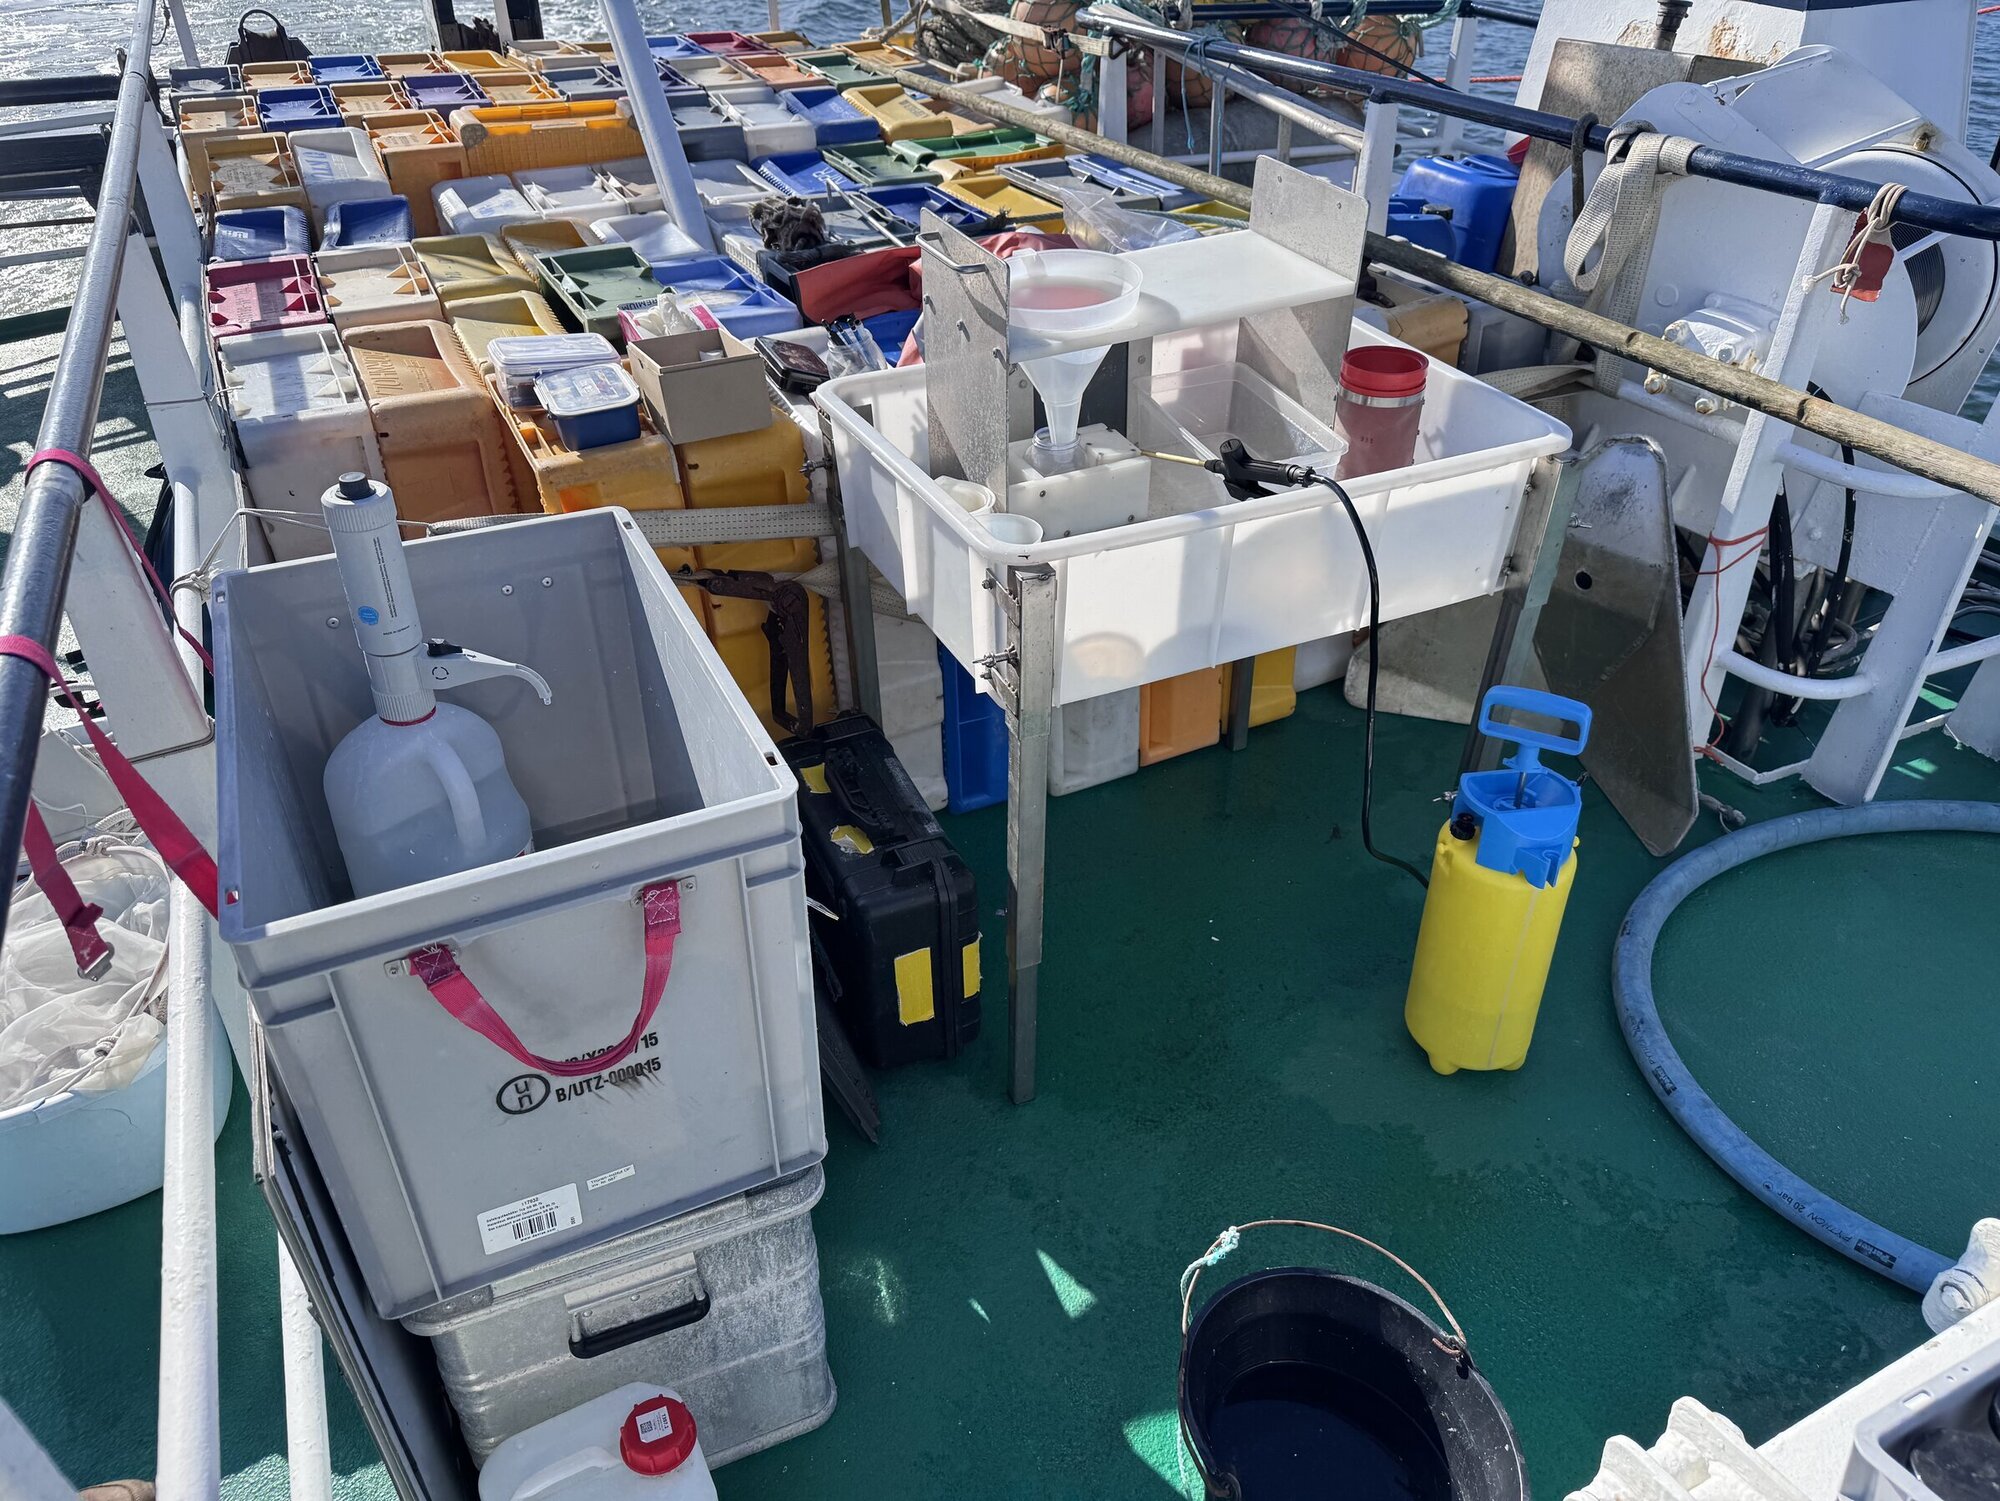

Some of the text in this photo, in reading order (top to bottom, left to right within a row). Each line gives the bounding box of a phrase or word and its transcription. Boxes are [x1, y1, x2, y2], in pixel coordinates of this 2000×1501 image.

[1777, 1190, 1793, 1205] bar
[1793, 1201, 1806, 1214] 20
[1807, 1211, 1853, 1242] PYTHON
